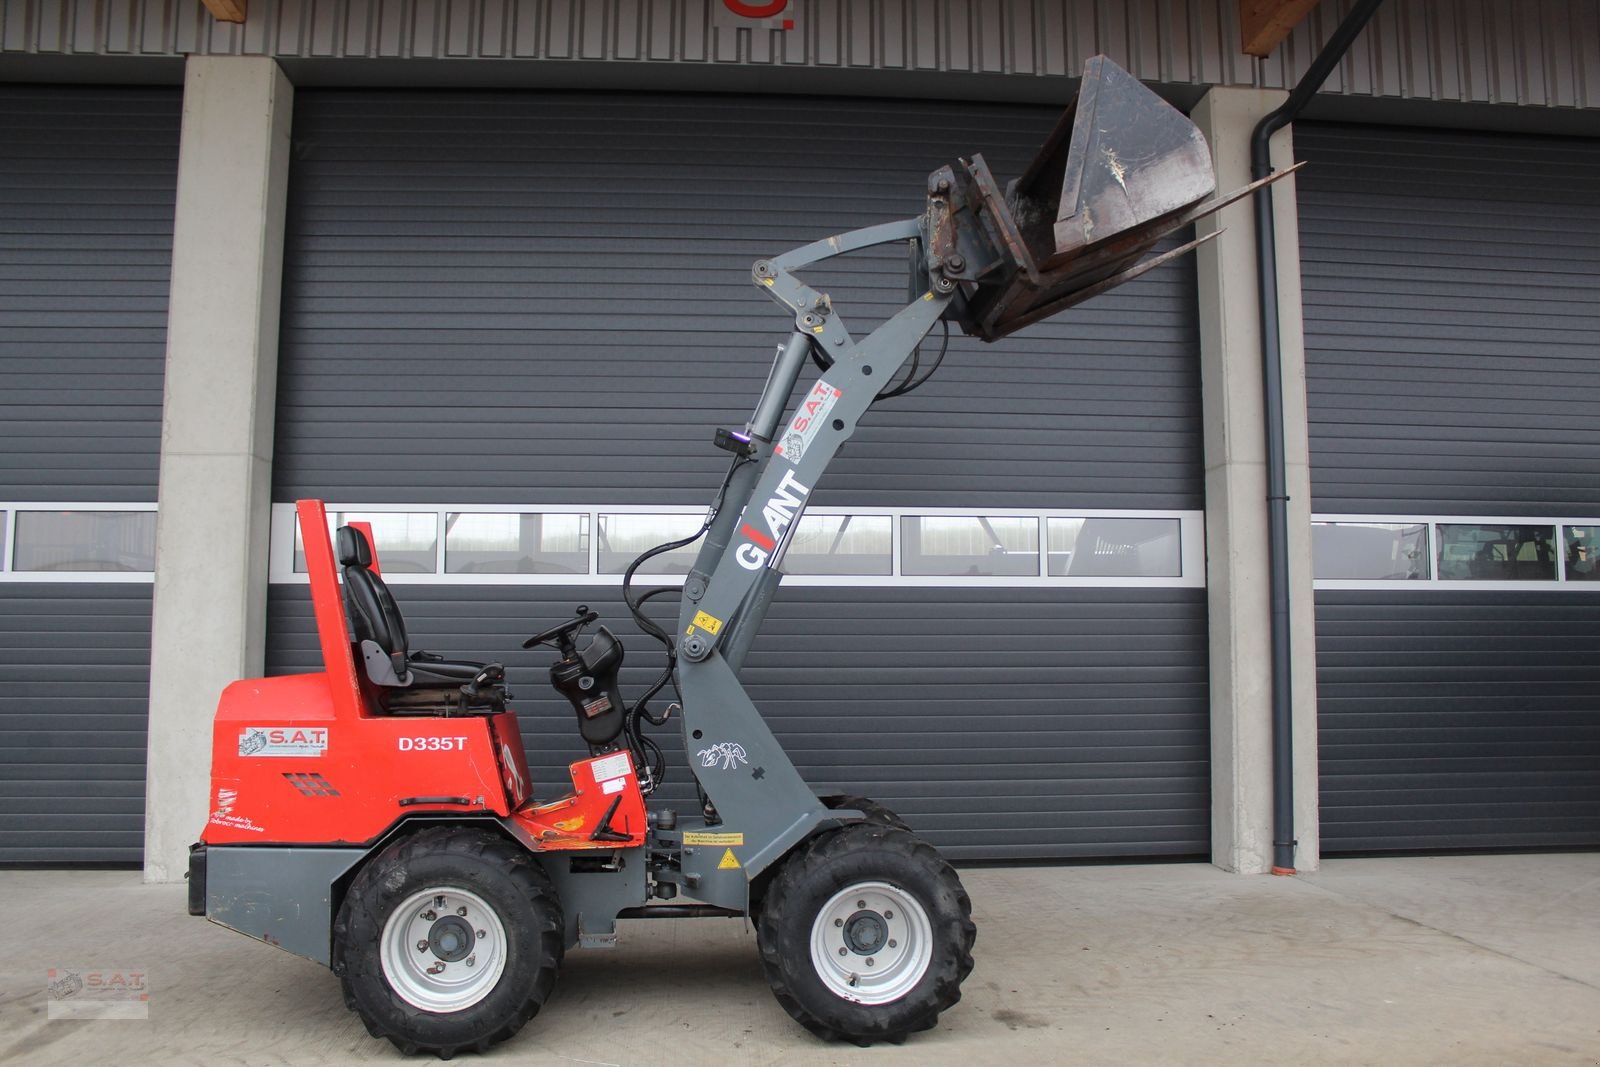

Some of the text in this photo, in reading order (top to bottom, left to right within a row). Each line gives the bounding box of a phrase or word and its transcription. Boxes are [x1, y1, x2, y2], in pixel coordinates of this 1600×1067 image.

[793, 382, 830, 433] S.A.T.
[735, 468, 810, 572] GIANT
[269, 730, 326, 744] S.A.T.
[398, 736, 468, 751] D335T
